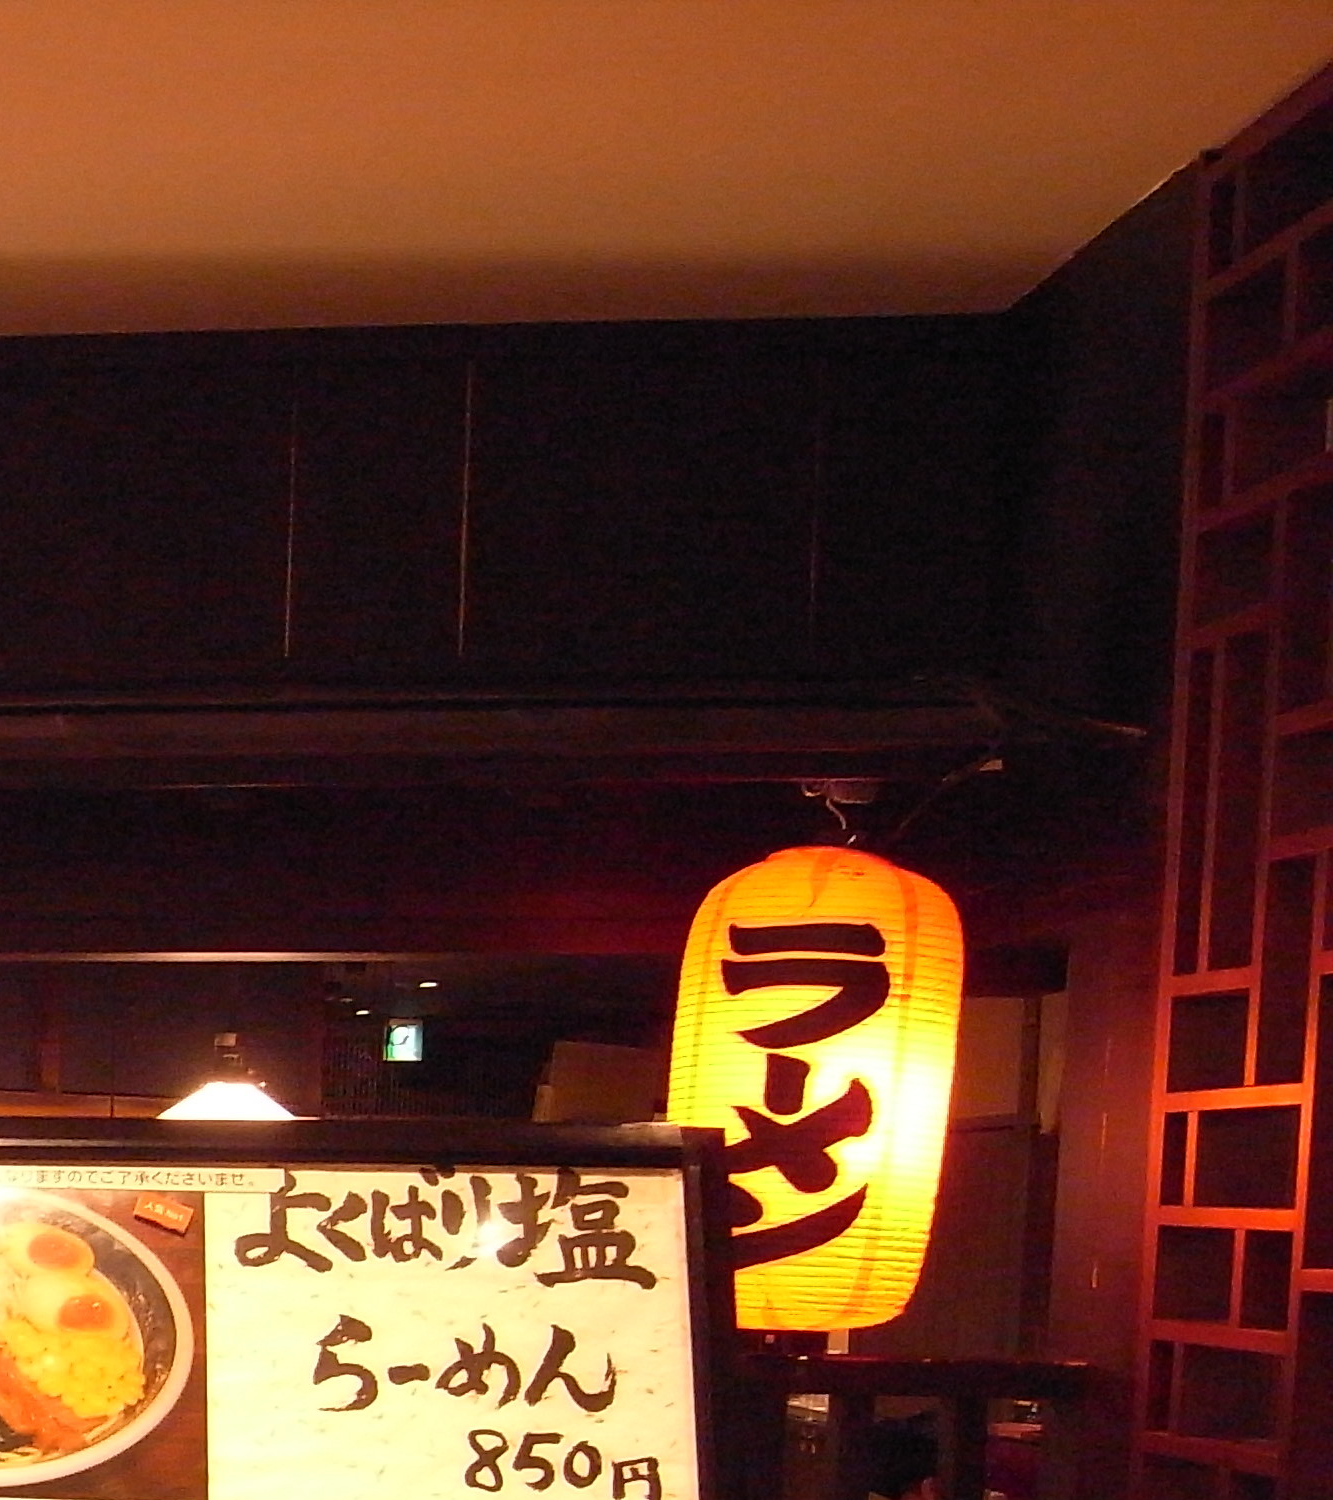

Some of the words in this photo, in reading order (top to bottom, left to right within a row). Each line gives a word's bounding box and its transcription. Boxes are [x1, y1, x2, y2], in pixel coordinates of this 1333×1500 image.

[721, 923, 891, 1272] ラーメン
[312, 1313, 619, 1413] らーめん
